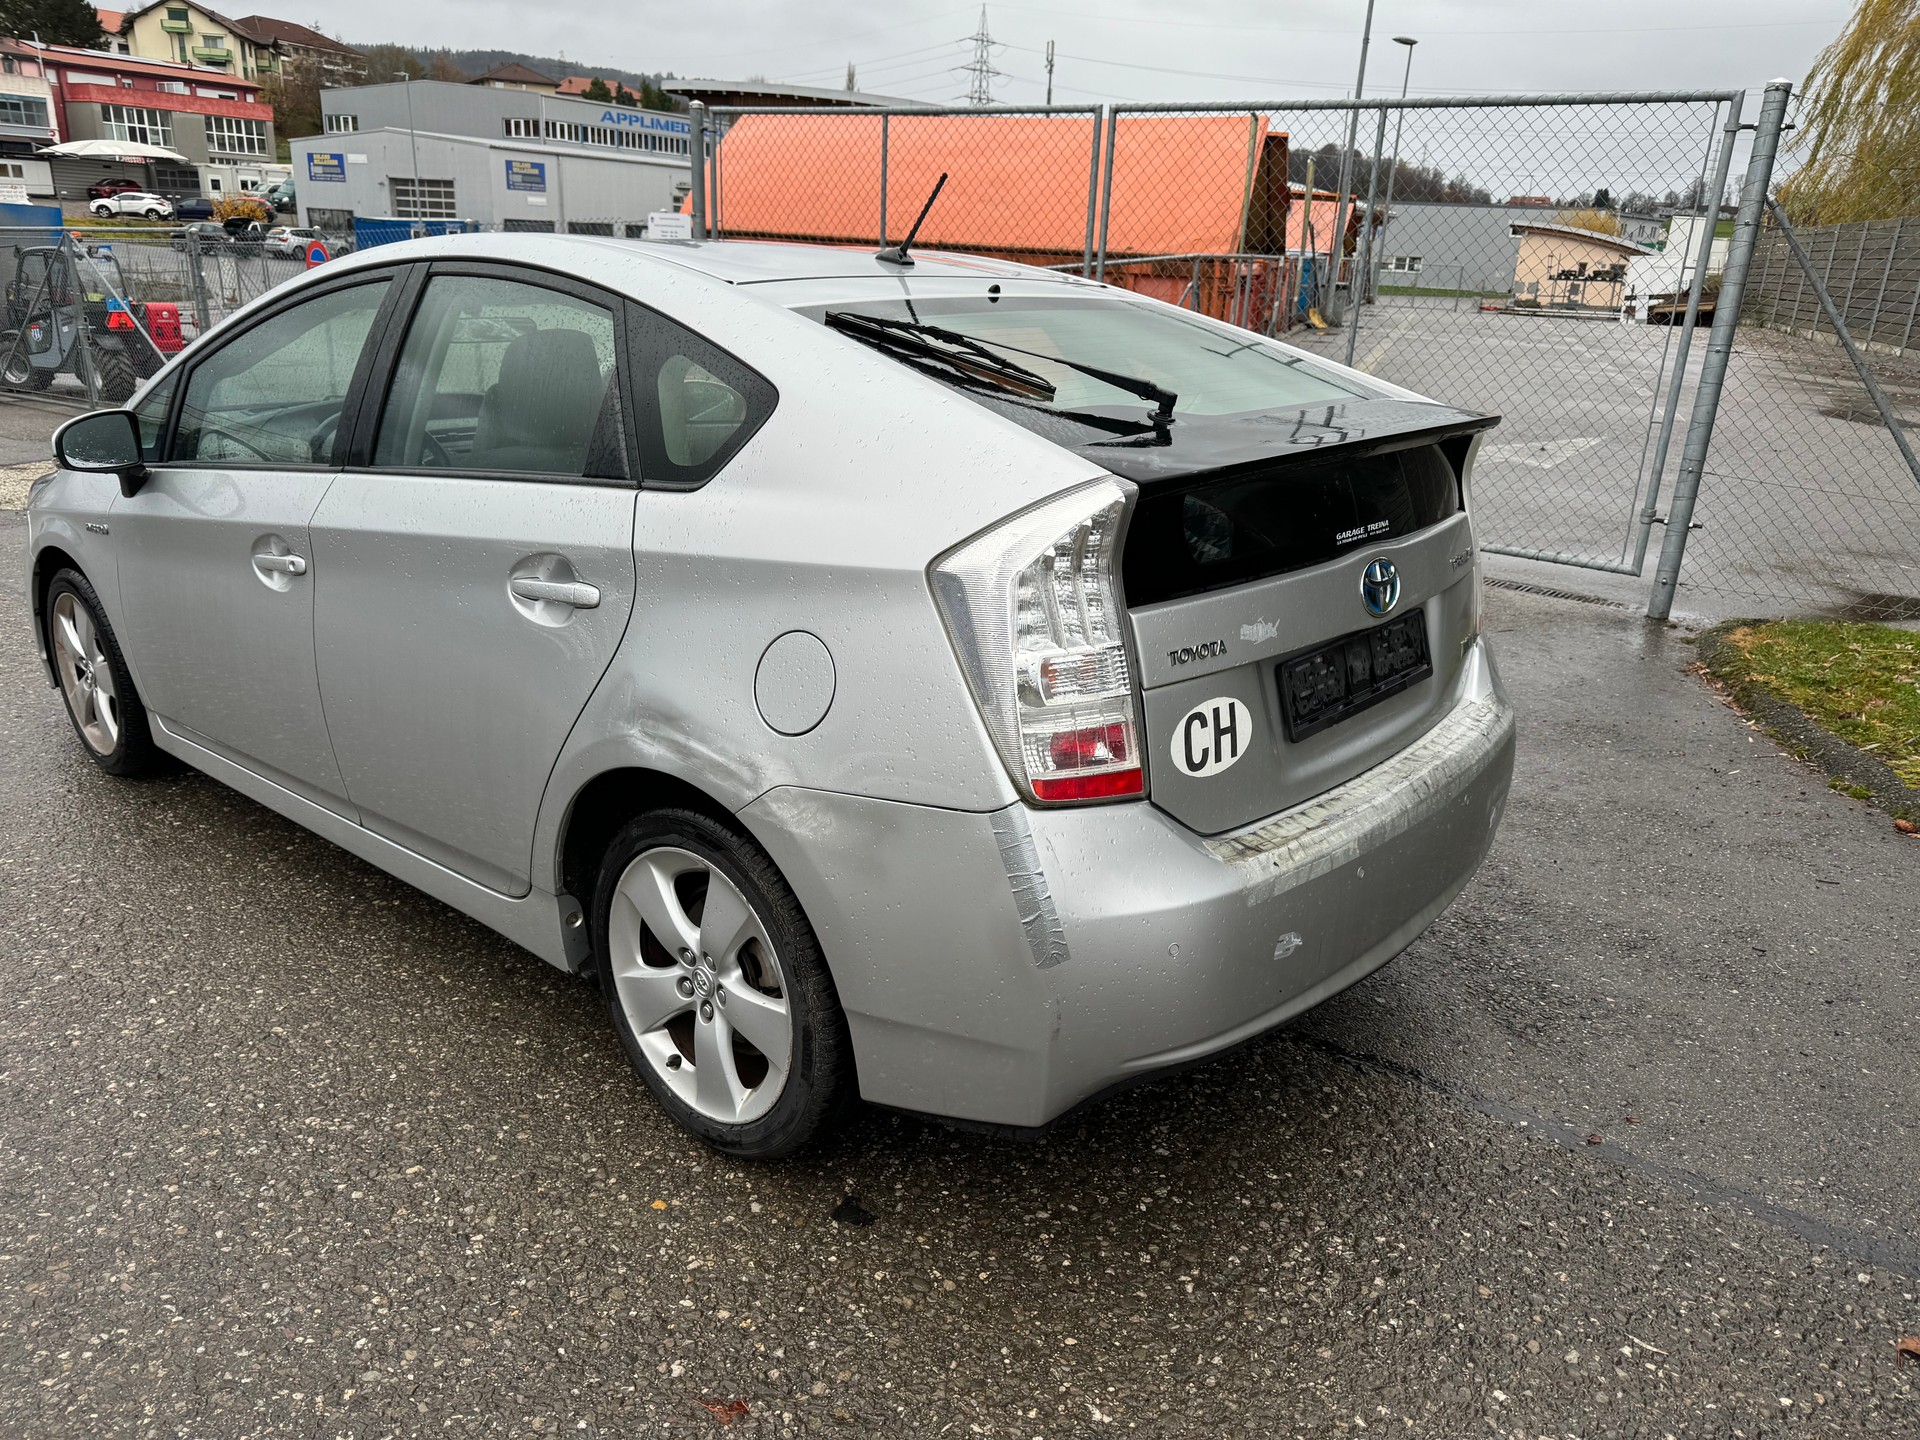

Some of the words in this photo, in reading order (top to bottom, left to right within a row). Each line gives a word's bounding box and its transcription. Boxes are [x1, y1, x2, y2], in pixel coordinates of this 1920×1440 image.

[1336, 526, 1366, 540] GARAGE
[1167, 640, 1227, 667] TOYOTA
[1184, 702, 1238, 773] CH
